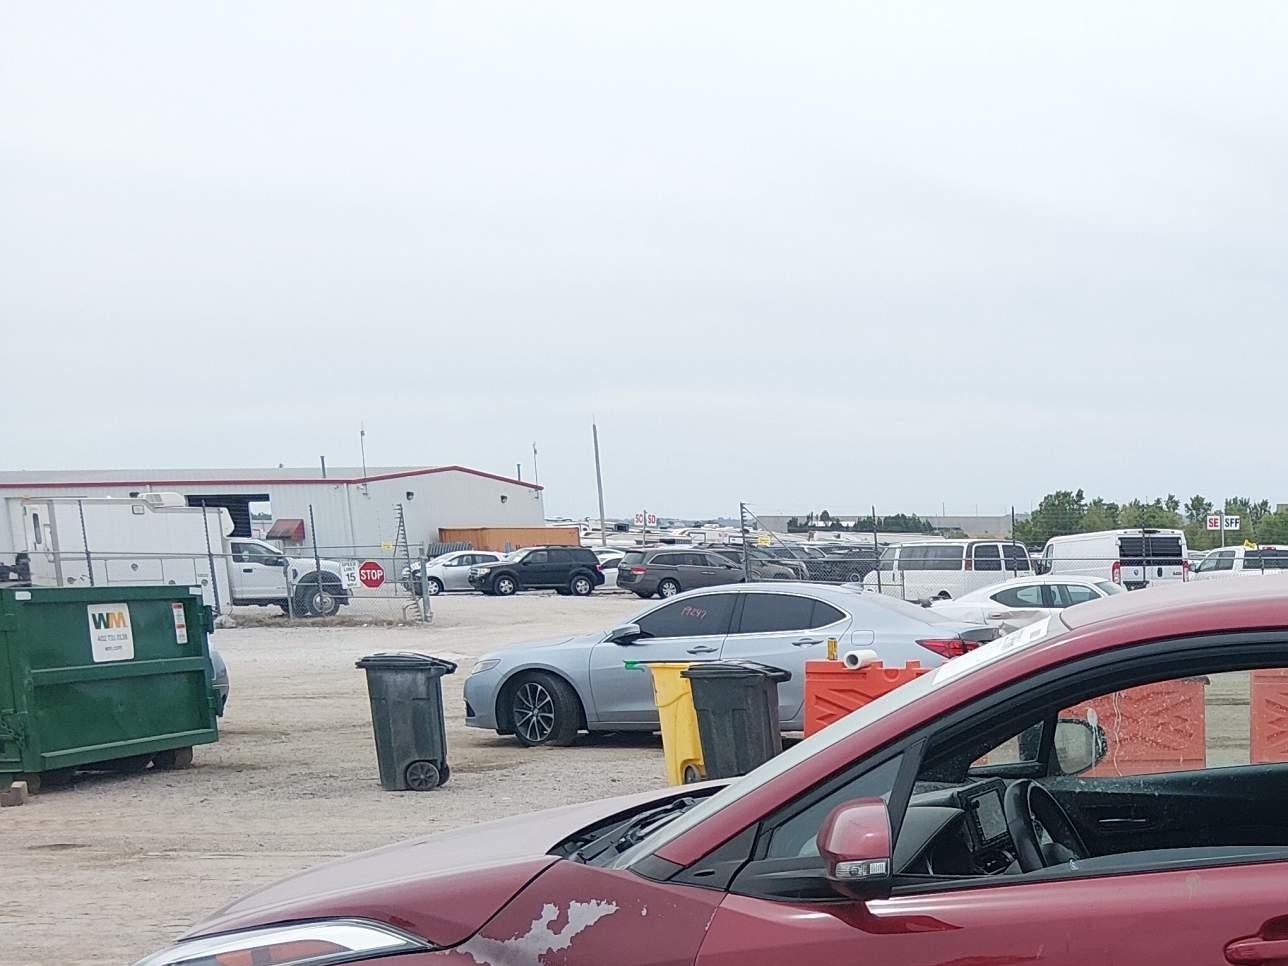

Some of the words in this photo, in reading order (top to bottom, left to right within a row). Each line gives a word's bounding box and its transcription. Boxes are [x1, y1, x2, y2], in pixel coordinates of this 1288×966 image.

[1208, 518, 1220, 528] SE
[1225, 518, 1240, 528] SFF
[345, 572, 356, 582] 15
[360, 569, 383, 581] STOP
[91, 612, 128, 630] WM
